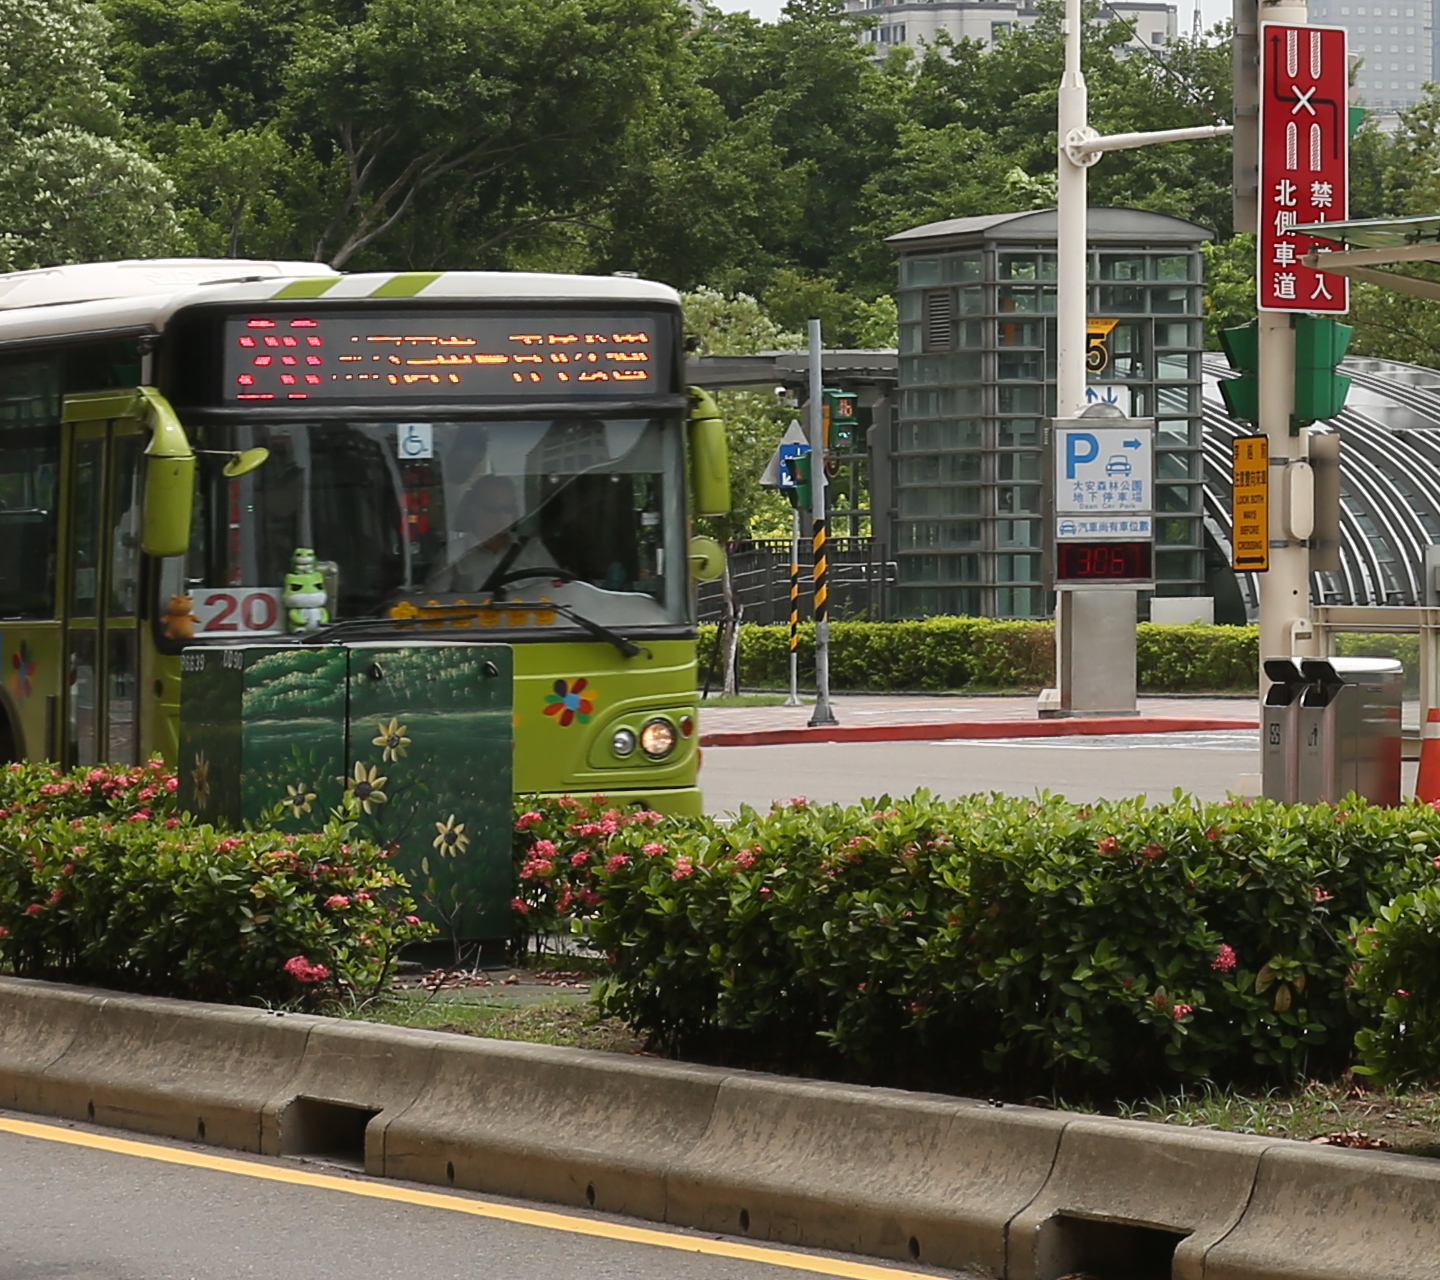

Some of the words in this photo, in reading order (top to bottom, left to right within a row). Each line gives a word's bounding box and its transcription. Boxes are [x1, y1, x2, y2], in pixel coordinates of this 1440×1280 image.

[1273, 179, 1297, 300] 北側車道
[1310, 180, 1333, 300] 禁入
[1066, 433, 1099, 479] P
[1073, 480, 1142, 491] 大安森林公園
[203, 593, 278, 632] 20
